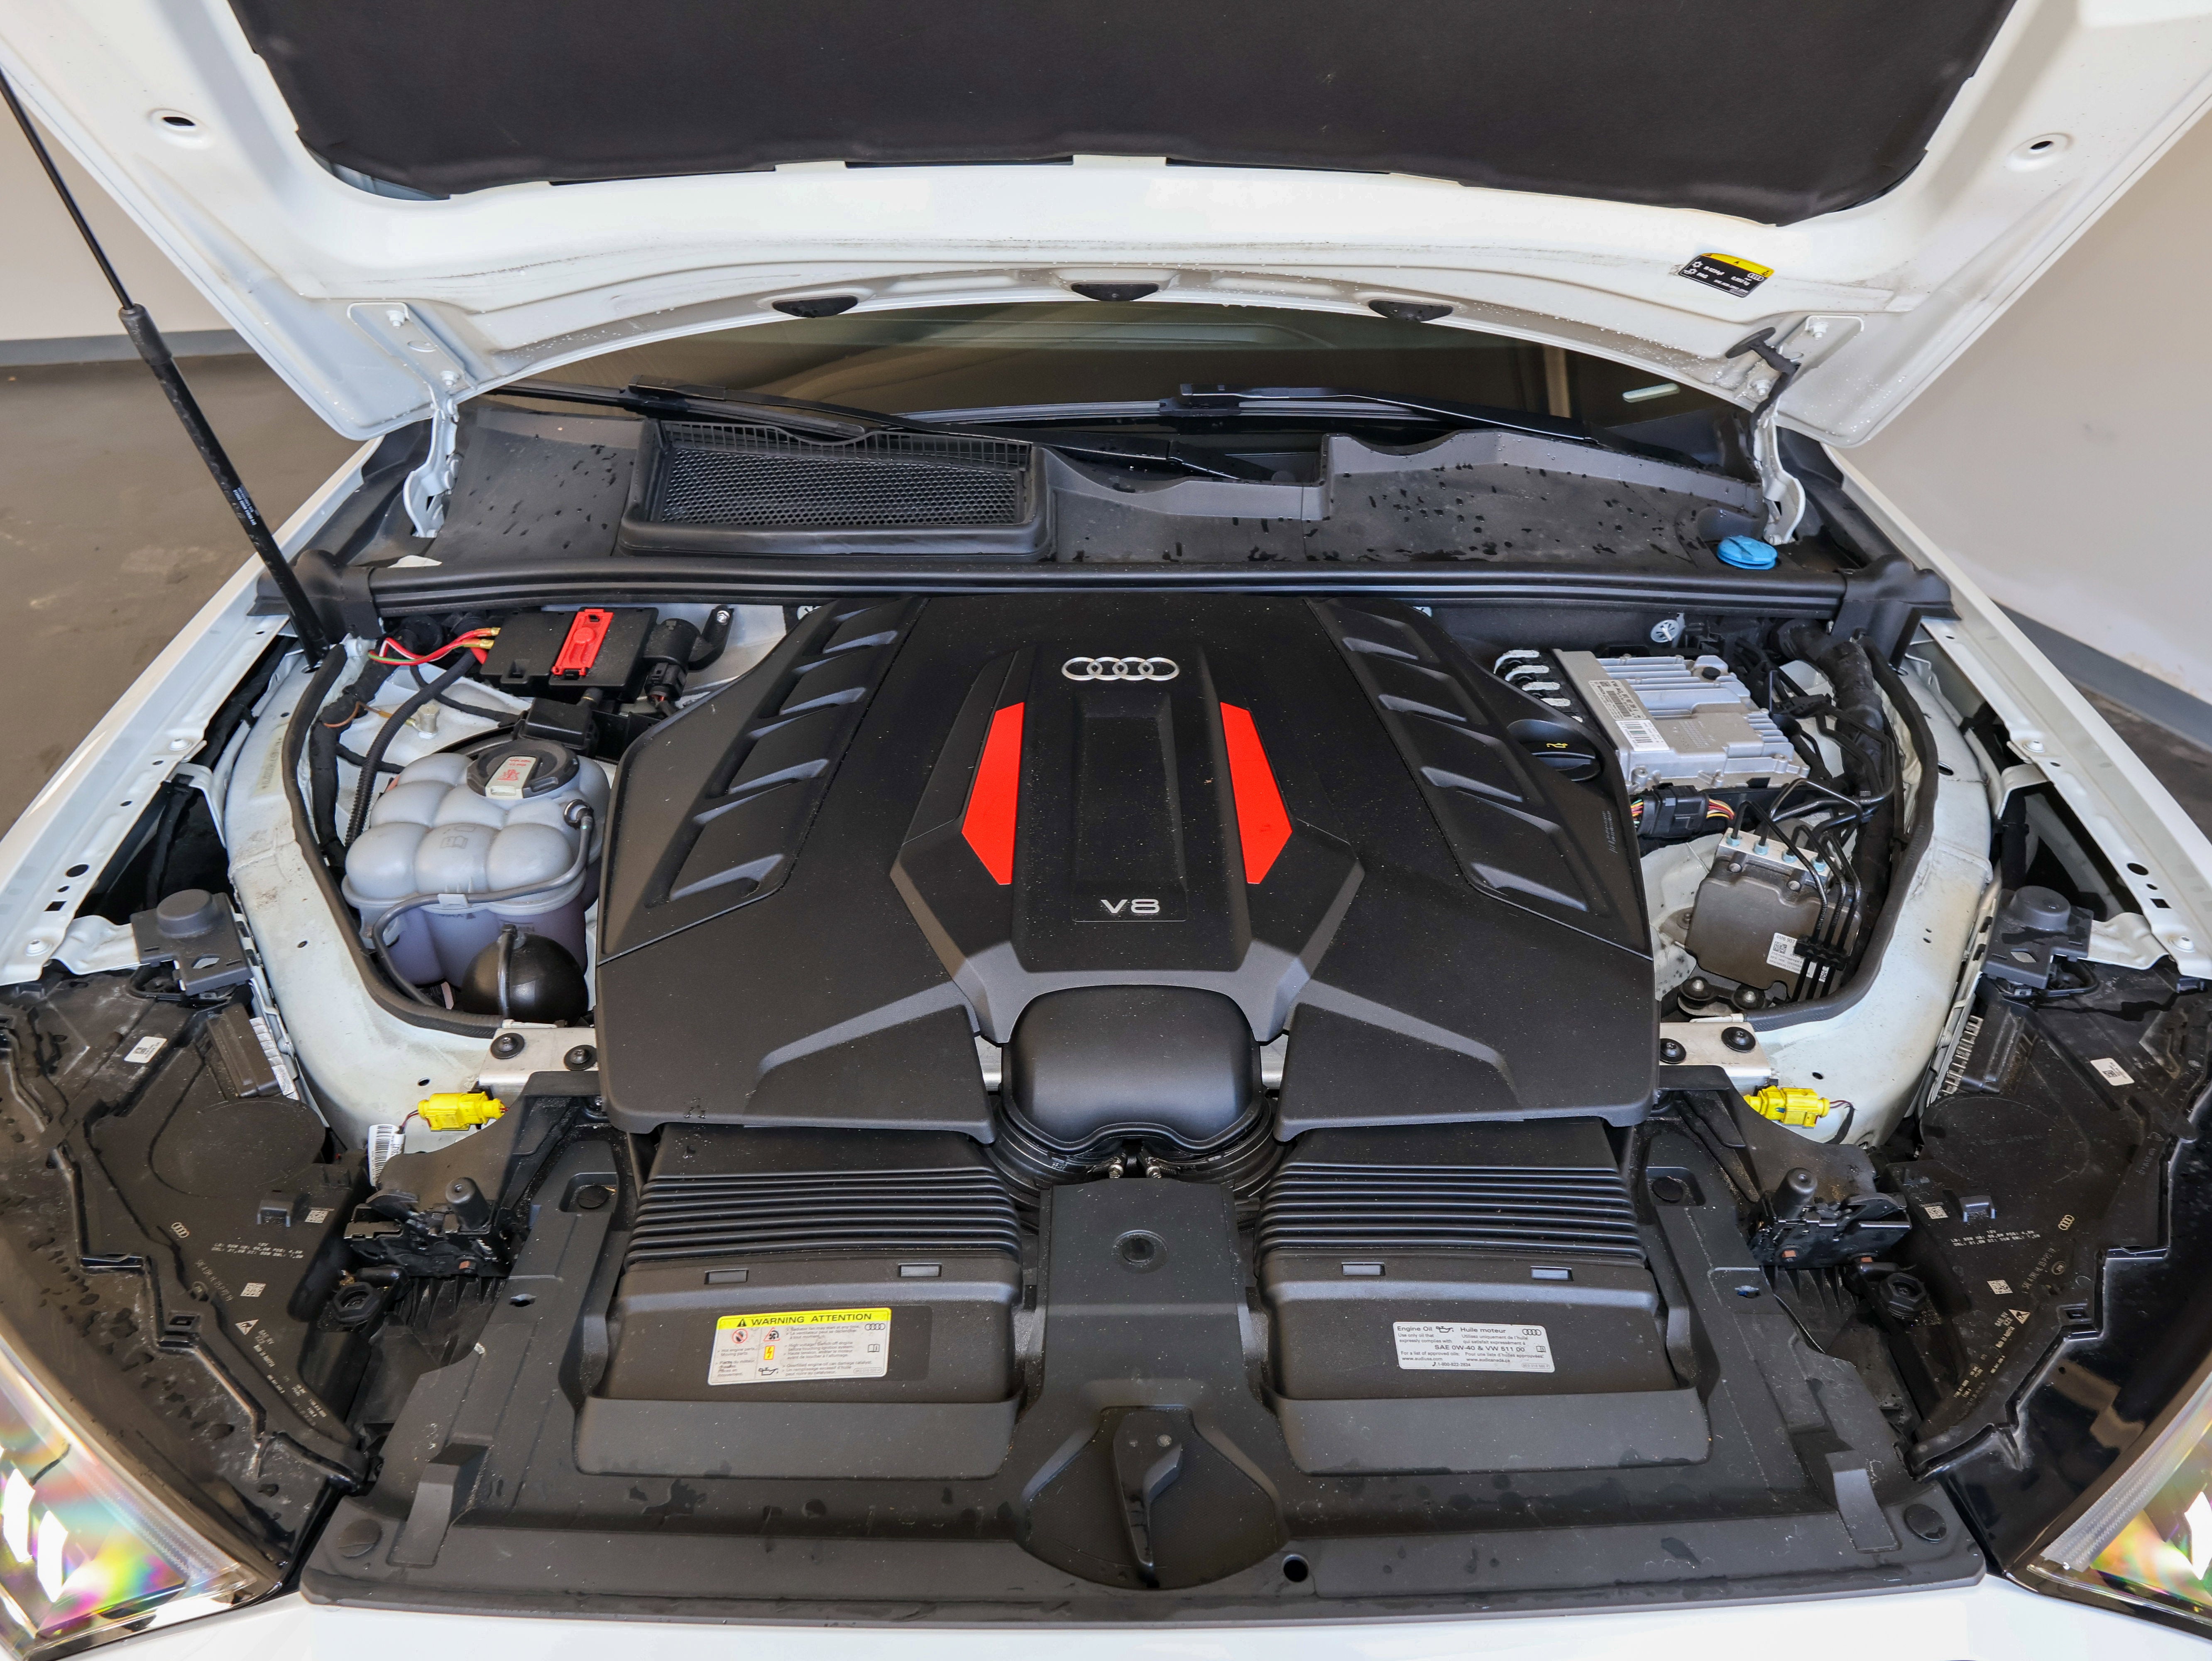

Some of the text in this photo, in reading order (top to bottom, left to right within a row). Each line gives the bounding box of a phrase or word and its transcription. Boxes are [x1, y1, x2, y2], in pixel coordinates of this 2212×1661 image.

[1101, 898, 1160, 914] V8
[751, 1313, 872, 1325] WARNING ATTENTION
